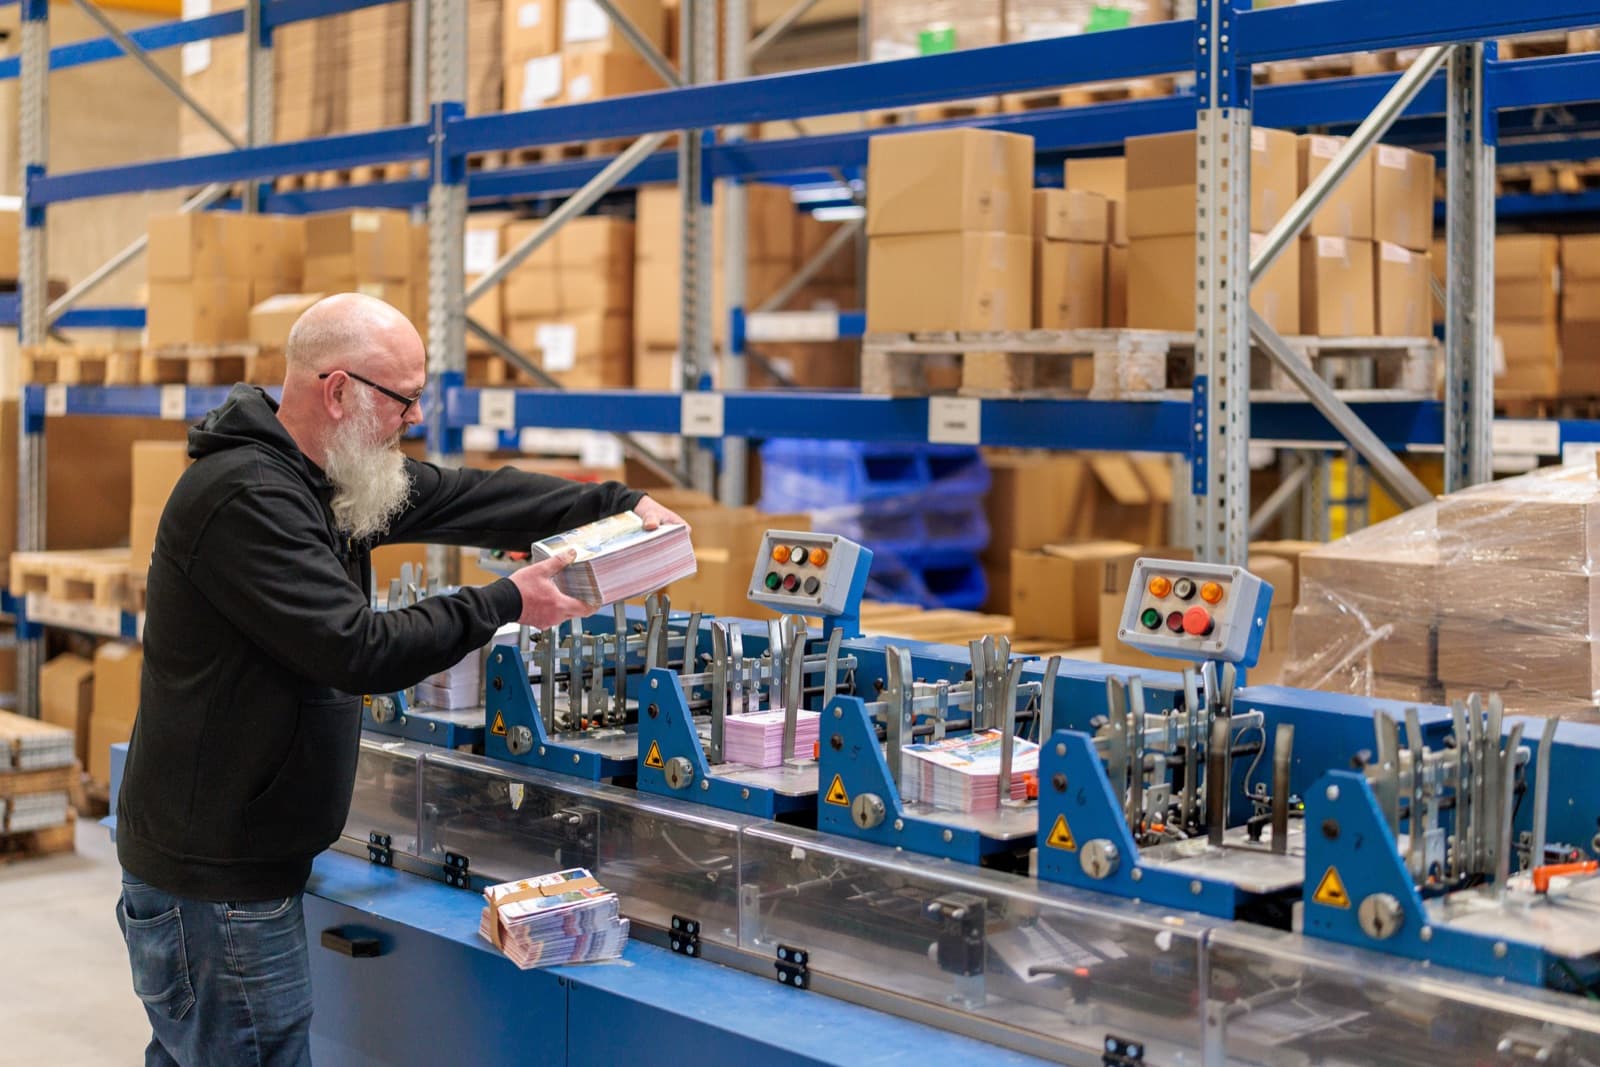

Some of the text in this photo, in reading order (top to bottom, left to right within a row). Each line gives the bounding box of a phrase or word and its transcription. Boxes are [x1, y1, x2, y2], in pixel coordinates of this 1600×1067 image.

[665, 711, 673, 729] 4
[850, 744, 862, 762] 5
[1075, 786, 1087, 807] 6
[1353, 831, 1365, 852] 7
